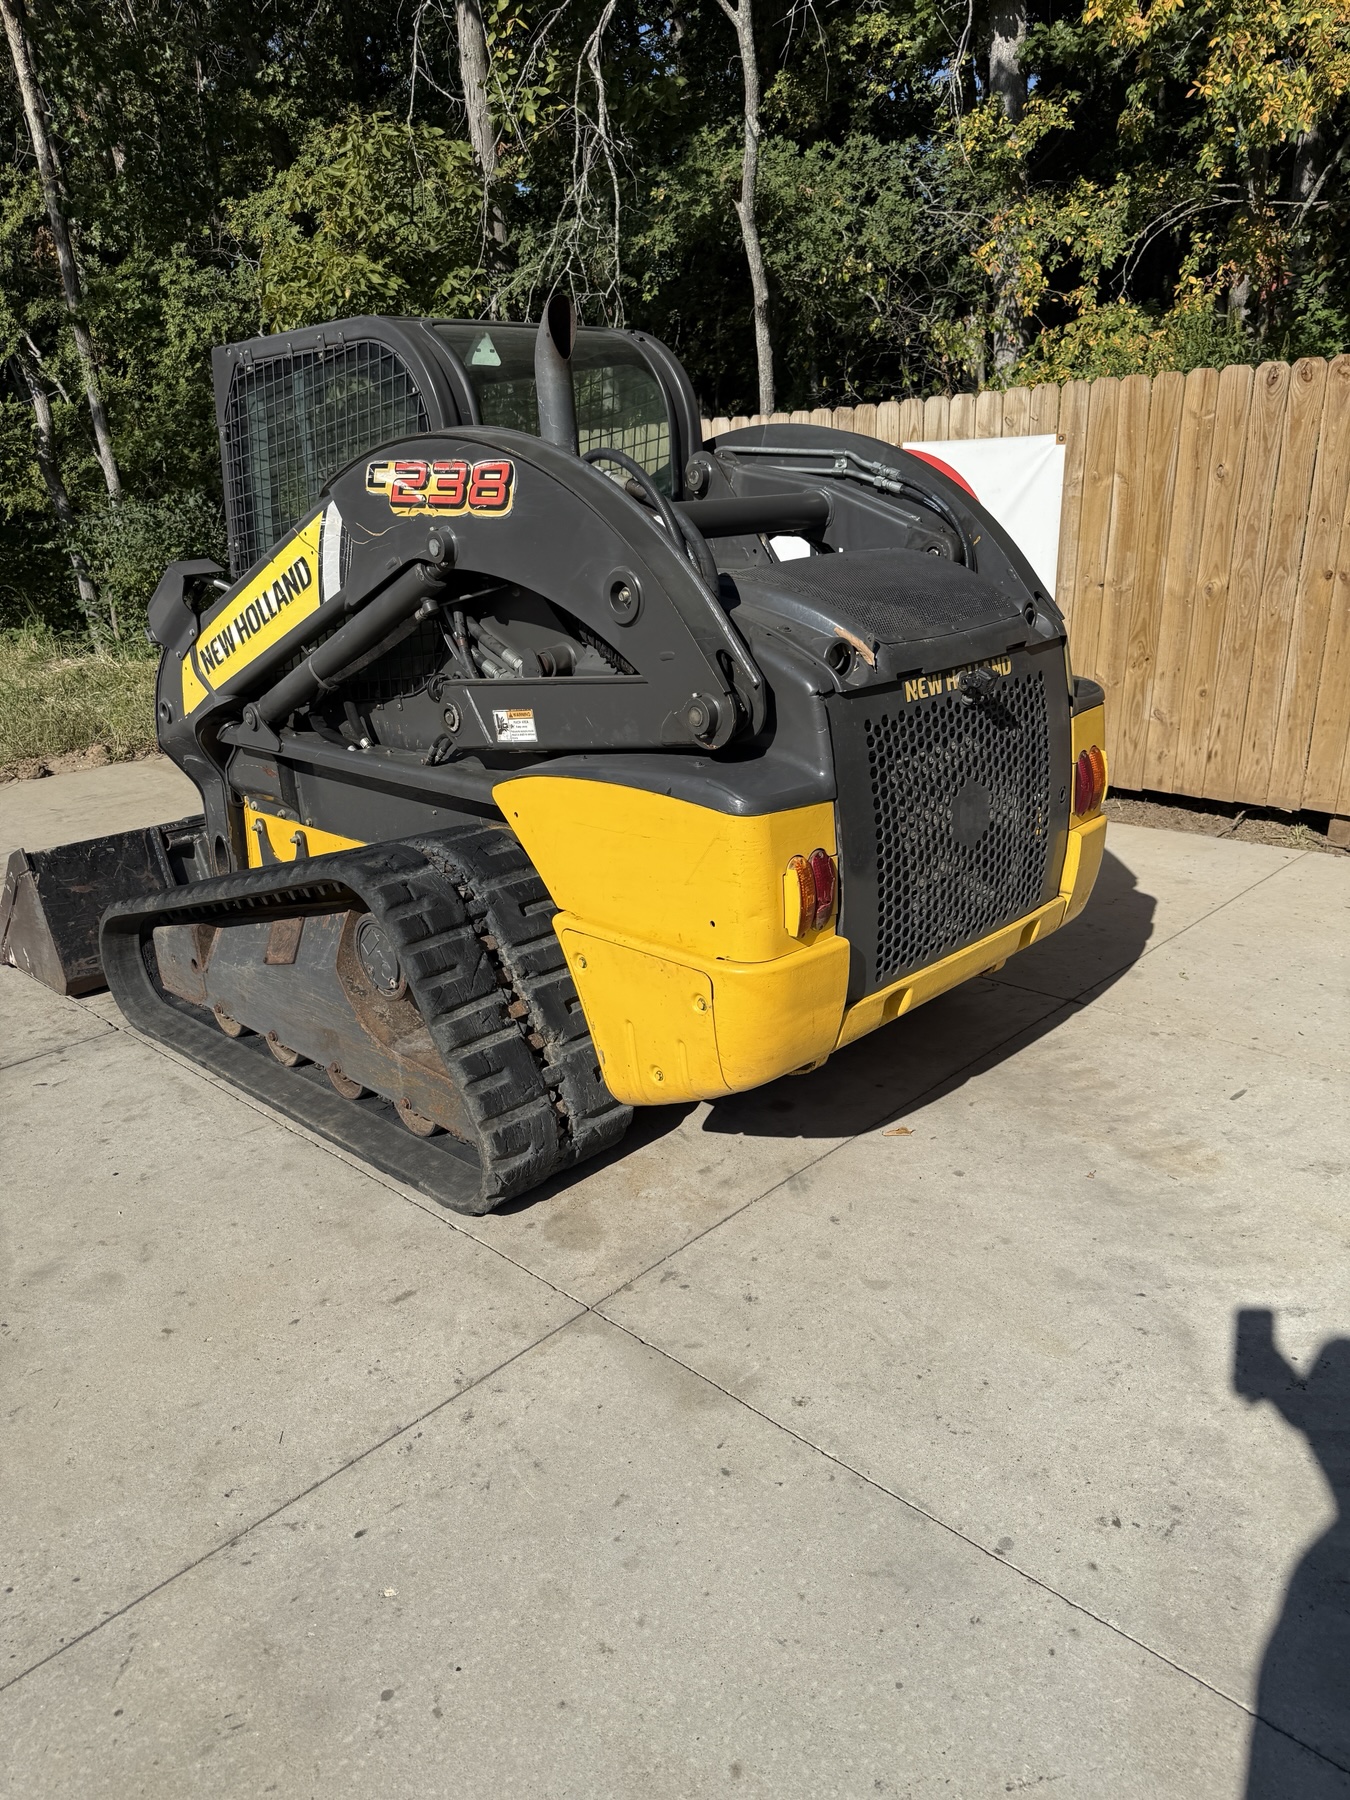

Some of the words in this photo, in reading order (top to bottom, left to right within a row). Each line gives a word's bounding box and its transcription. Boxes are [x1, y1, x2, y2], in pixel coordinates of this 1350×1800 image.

[200, 623, 237, 675] NEW
[233, 556, 312, 645] HOLLAND
[904, 673, 943, 703] NEW
